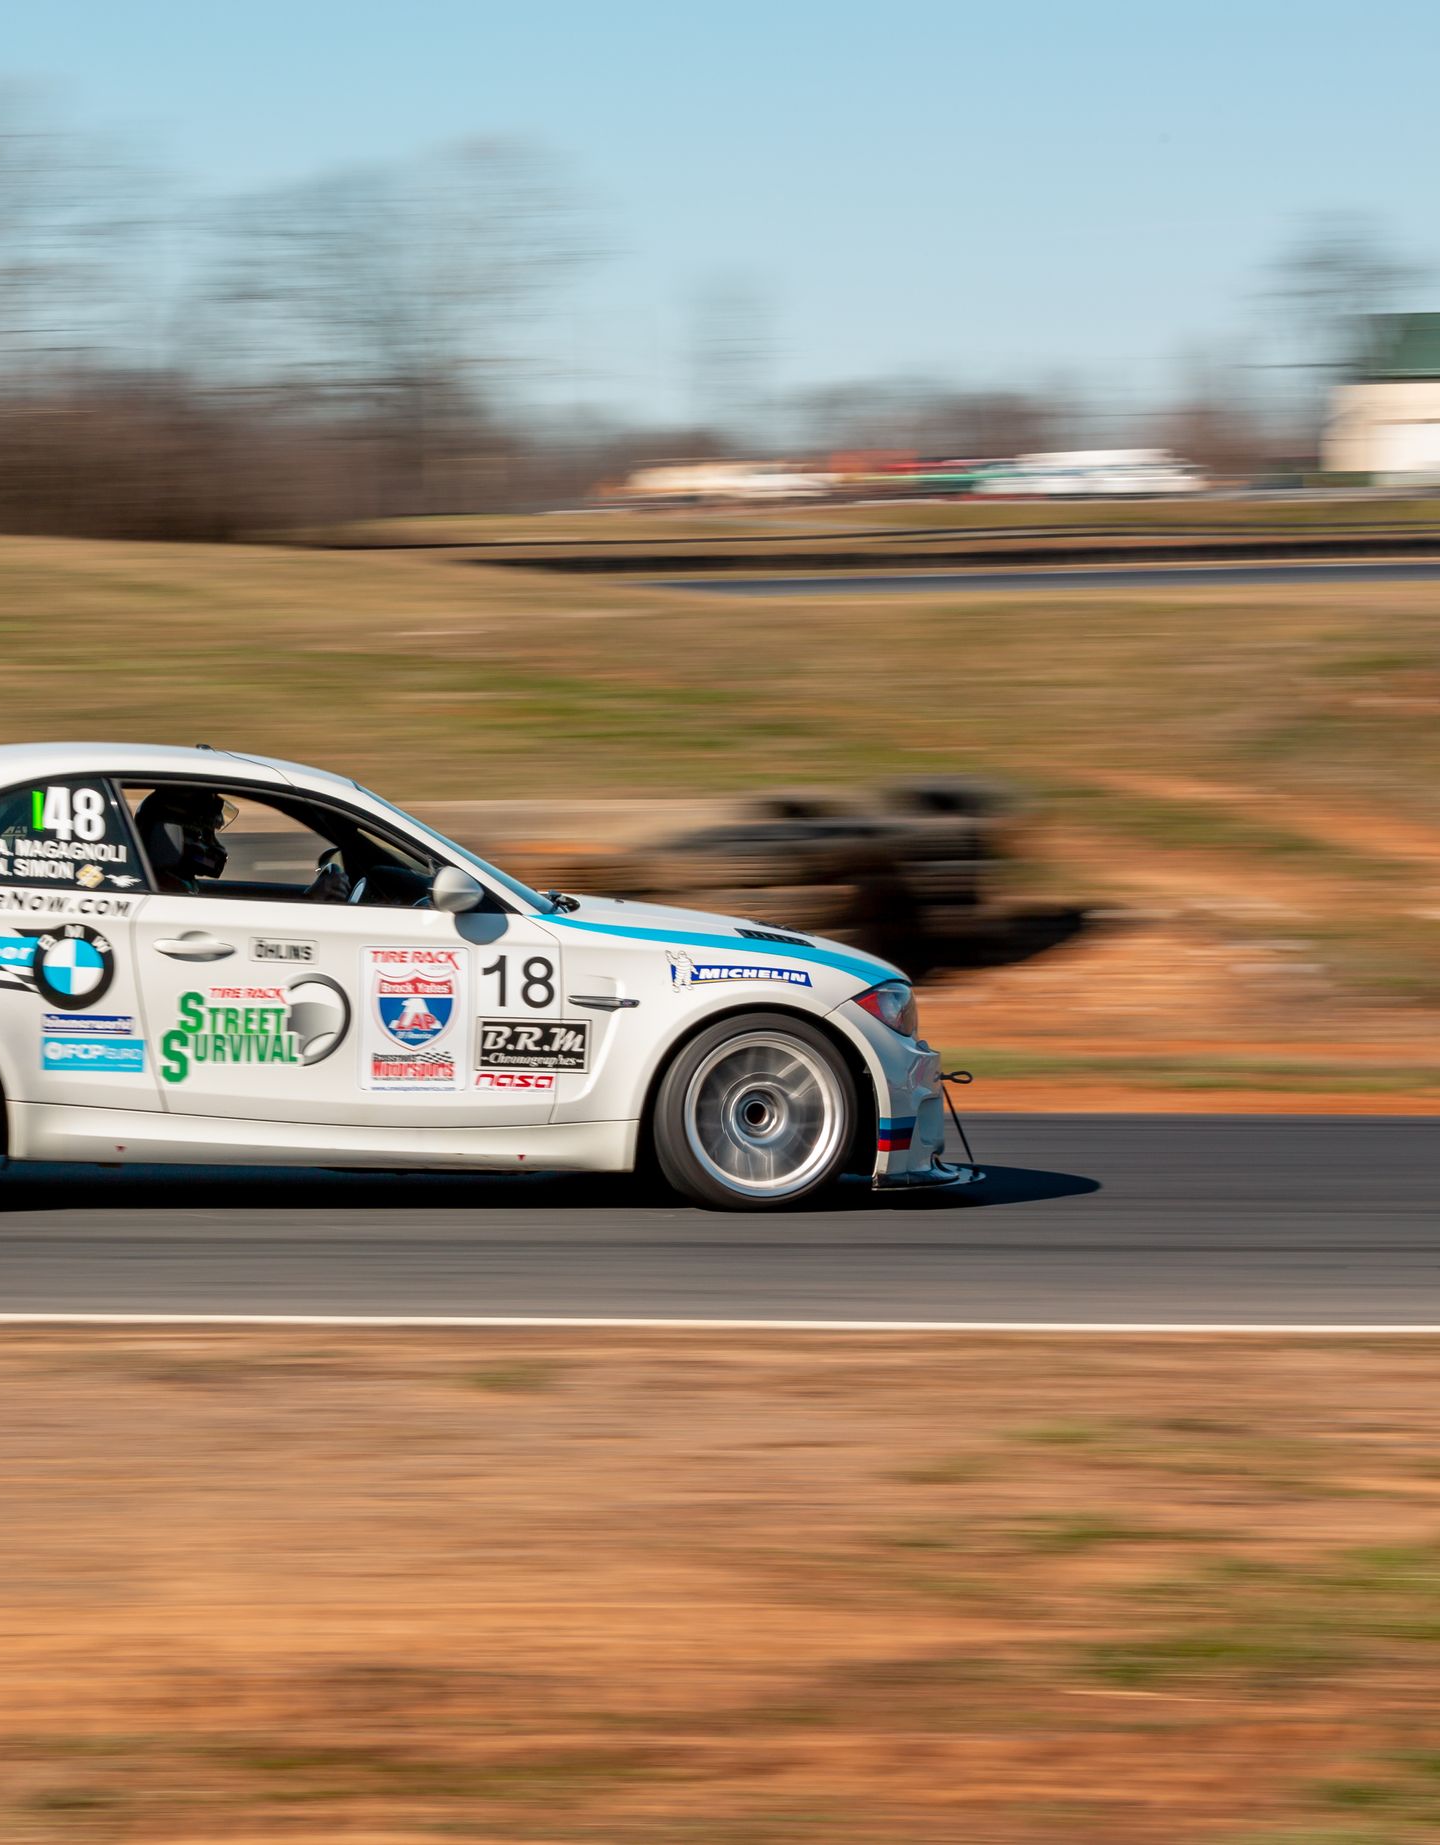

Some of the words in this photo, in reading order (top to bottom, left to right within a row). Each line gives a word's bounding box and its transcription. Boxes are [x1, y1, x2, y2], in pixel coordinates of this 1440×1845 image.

[15, 838, 127, 863] MAGAGNOLI
[13, 858, 74, 880] SIMON
[370, 951, 408, 963] TIRE
[410, 951, 461, 970] RACK
[482, 955, 555, 1009] 18
[698, 968, 807, 983] MICHELIN
[209, 987, 241, 999] TIRE
[243, 987, 288, 1005] RACK
[394, 1011, 436, 1030] LAP
[475, 1074, 554, 1089] nasa
